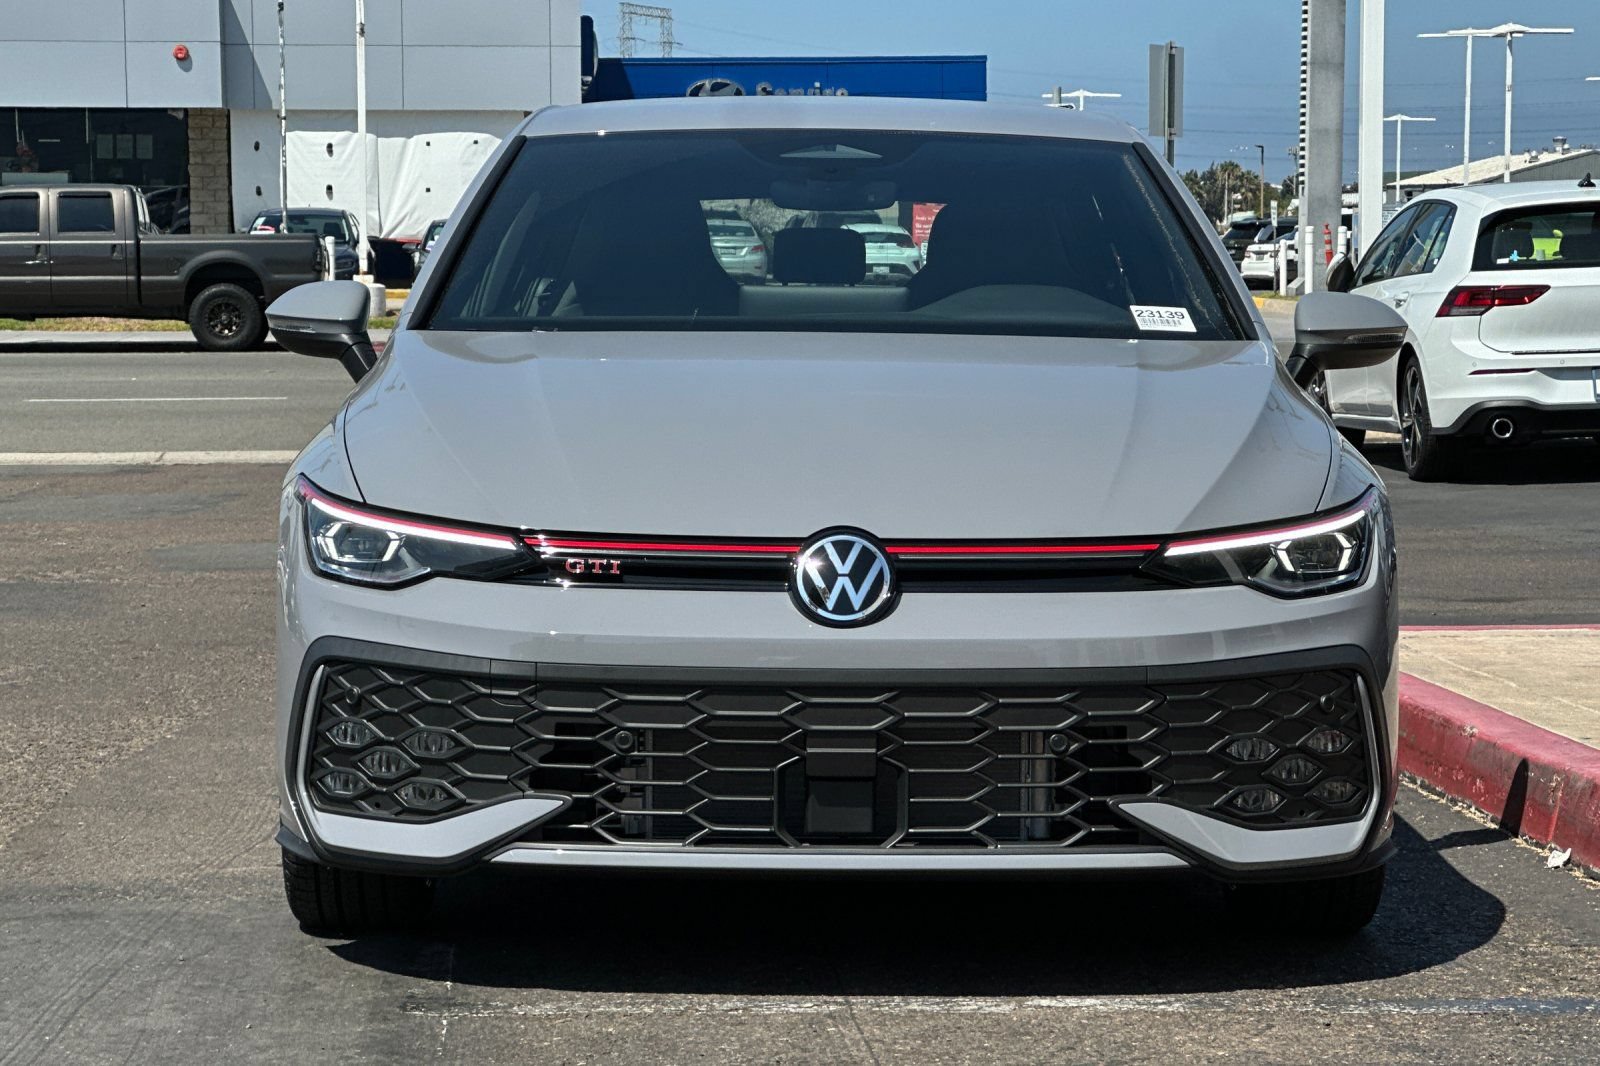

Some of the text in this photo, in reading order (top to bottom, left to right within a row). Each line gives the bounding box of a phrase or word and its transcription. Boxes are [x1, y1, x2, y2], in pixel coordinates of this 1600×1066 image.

[1134, 309, 1185, 320] 23139
[564, 558, 622, 575] GTI
[803, 540, 885, 612] VW
